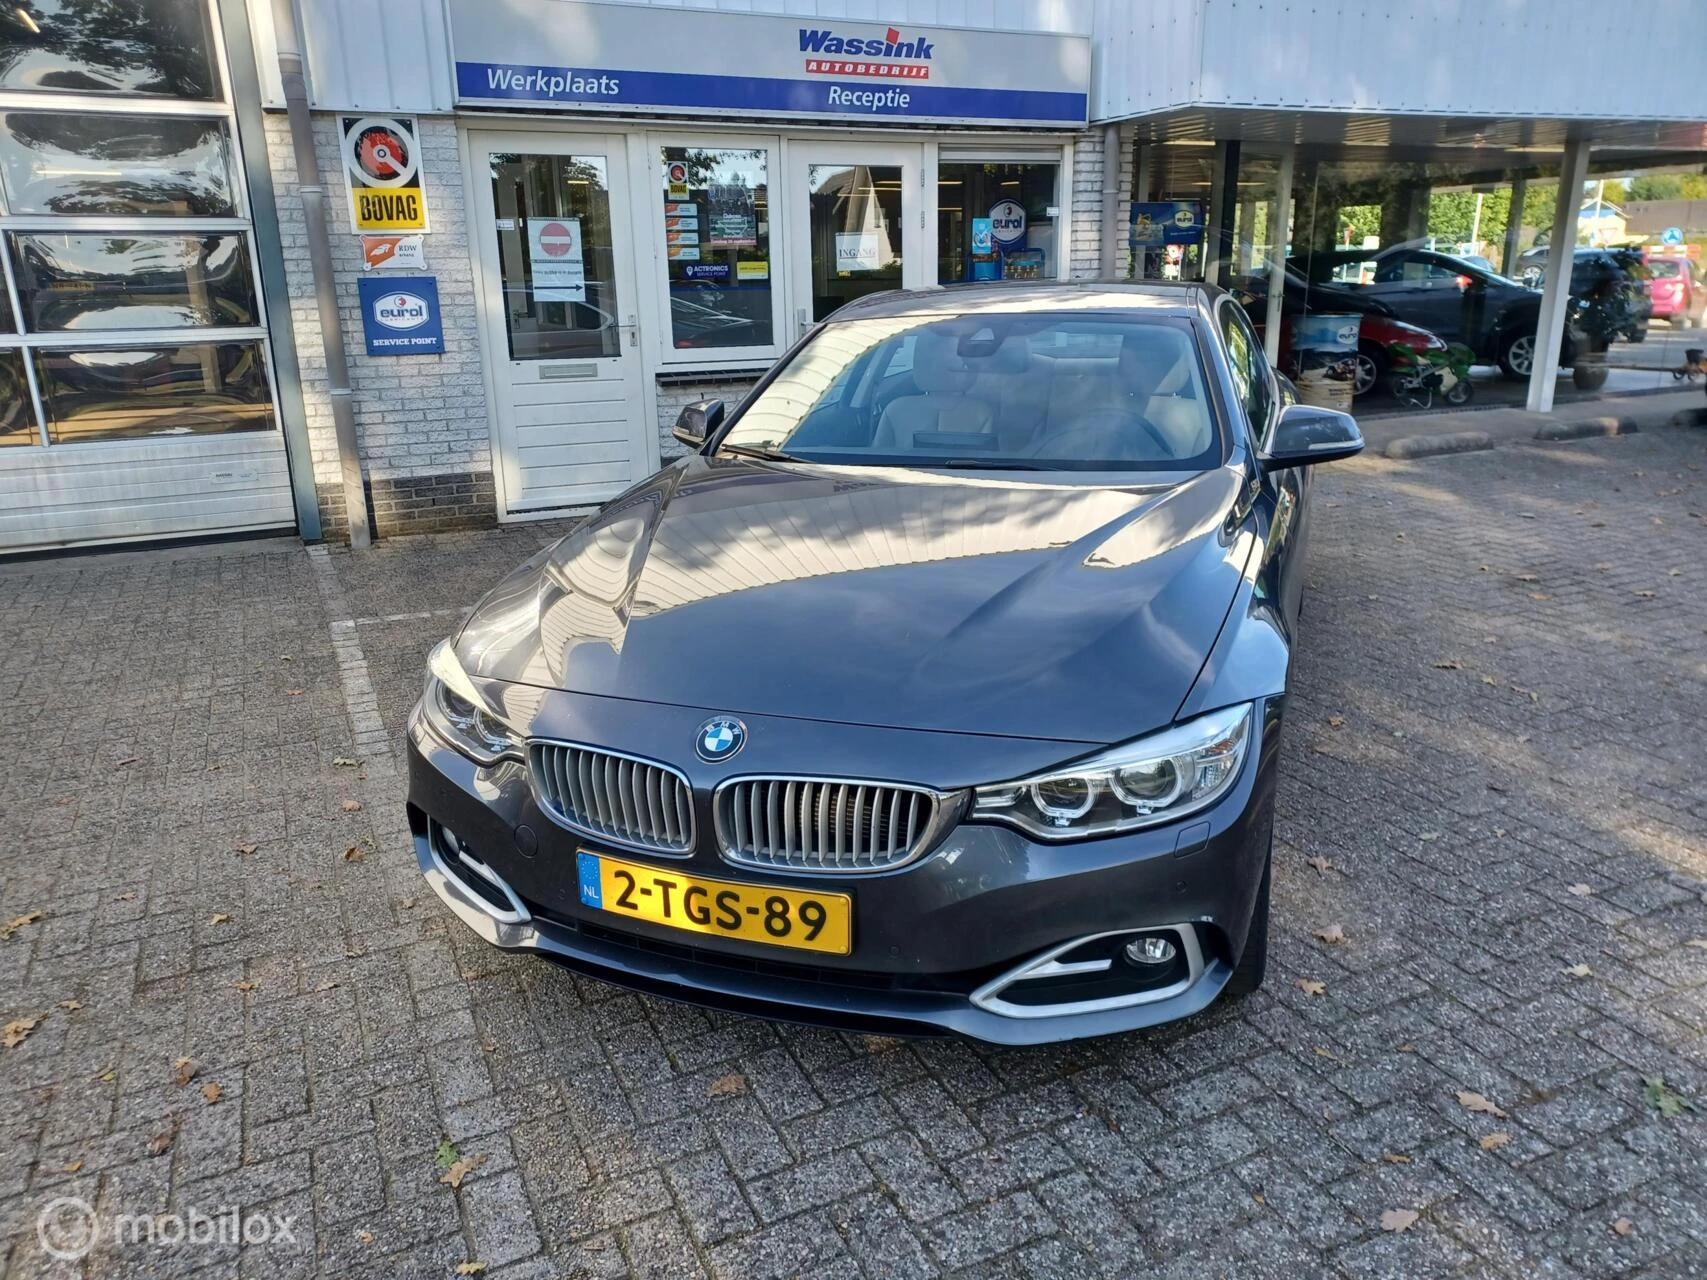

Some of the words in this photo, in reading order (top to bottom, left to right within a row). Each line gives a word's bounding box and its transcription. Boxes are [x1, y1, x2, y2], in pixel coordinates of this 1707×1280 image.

[799, 27, 935, 59] Wassink
[808, 61, 928, 76] AUTOBEDRIJF
[487, 68, 620, 97] Werkplaats
[828, 86, 910, 111] Receptie
[670, 184, 687, 193] BOVAG
[359, 194, 418, 221] BOVAG
[993, 215, 1022, 228] eurol
[398, 244, 417, 252] RDW
[839, 247, 876, 257] INGANG
[380, 305, 423, 318] eurol
[373, 338, 409, 347] SERVICE
[411, 337, 437, 345] POINT
[704, 720, 741, 734] BMW
[583, 884, 600, 899] NL
[613, 869, 828, 942] 2-TGS-89
